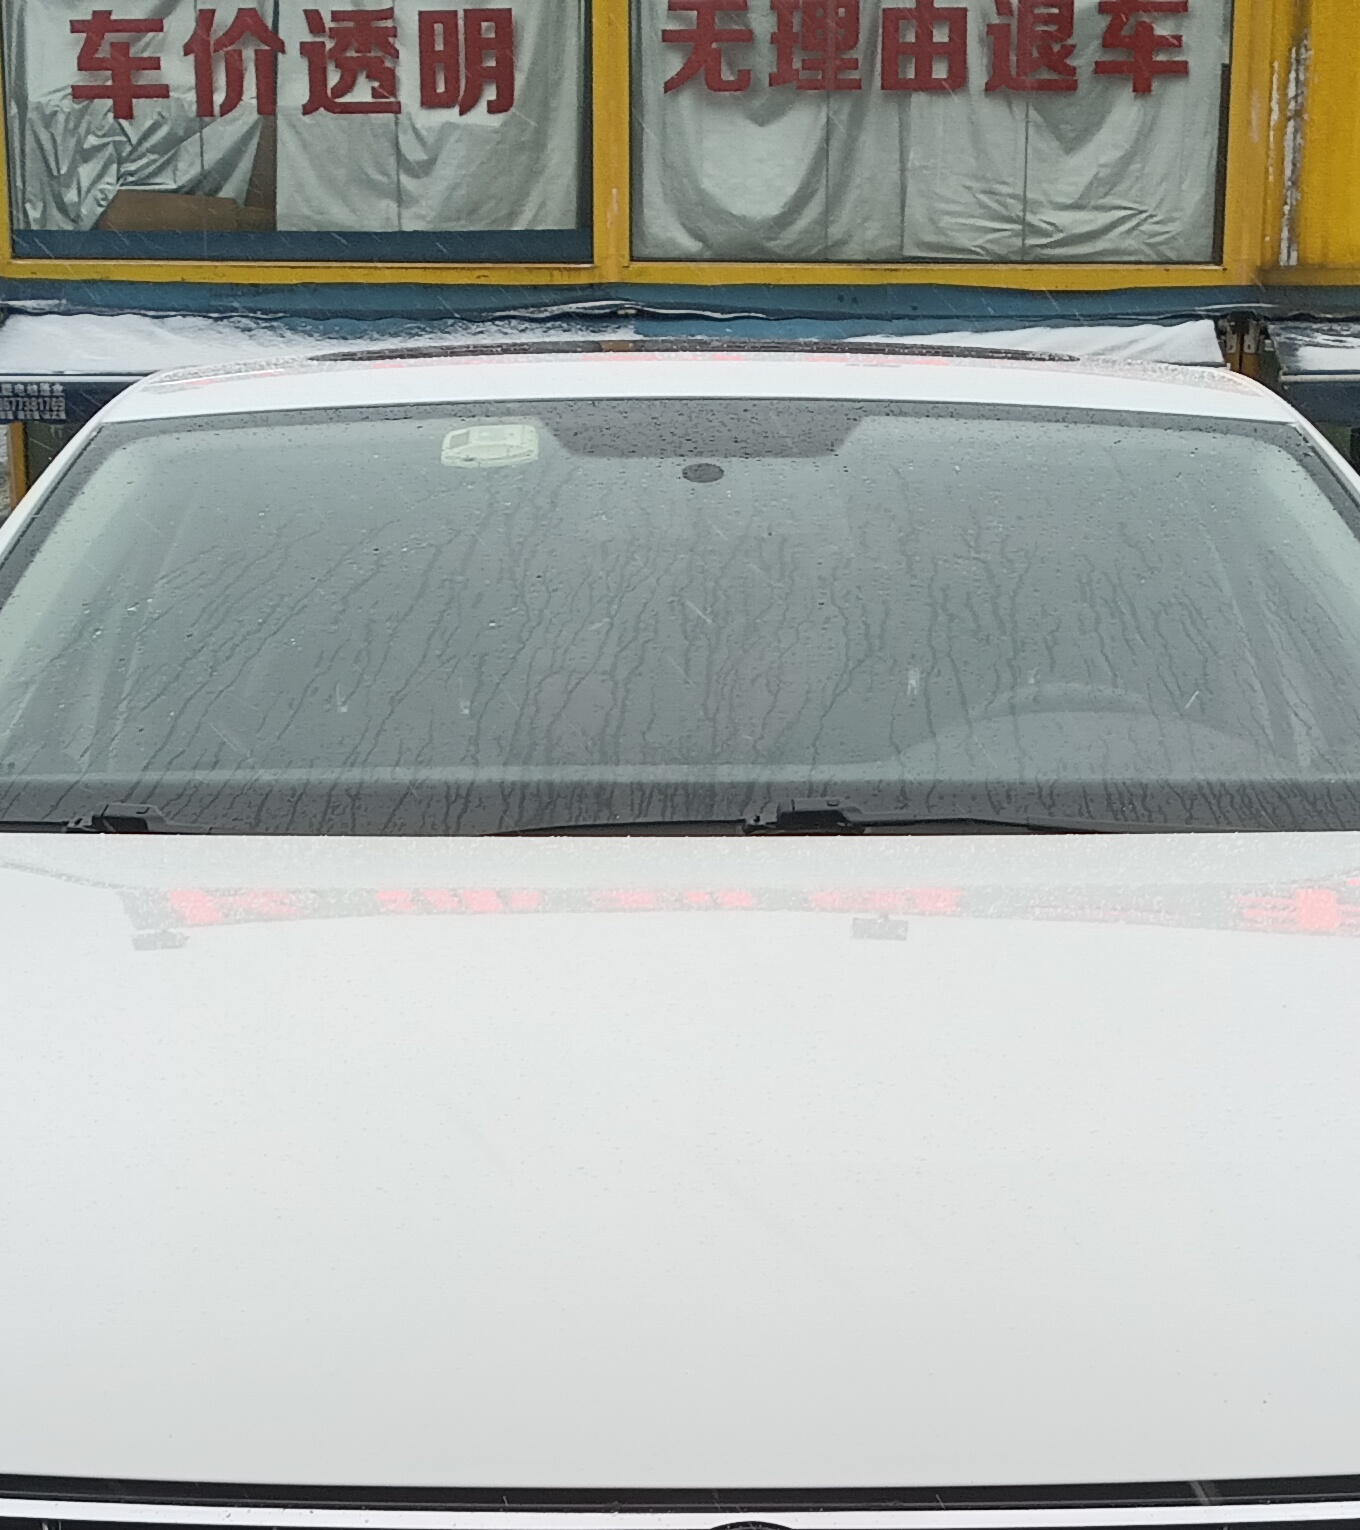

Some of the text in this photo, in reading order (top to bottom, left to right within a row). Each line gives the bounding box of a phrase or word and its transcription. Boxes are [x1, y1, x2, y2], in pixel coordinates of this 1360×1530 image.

[68, 7, 516, 121] 车价透明
[661, 0, 1190, 94] 无理由退车
